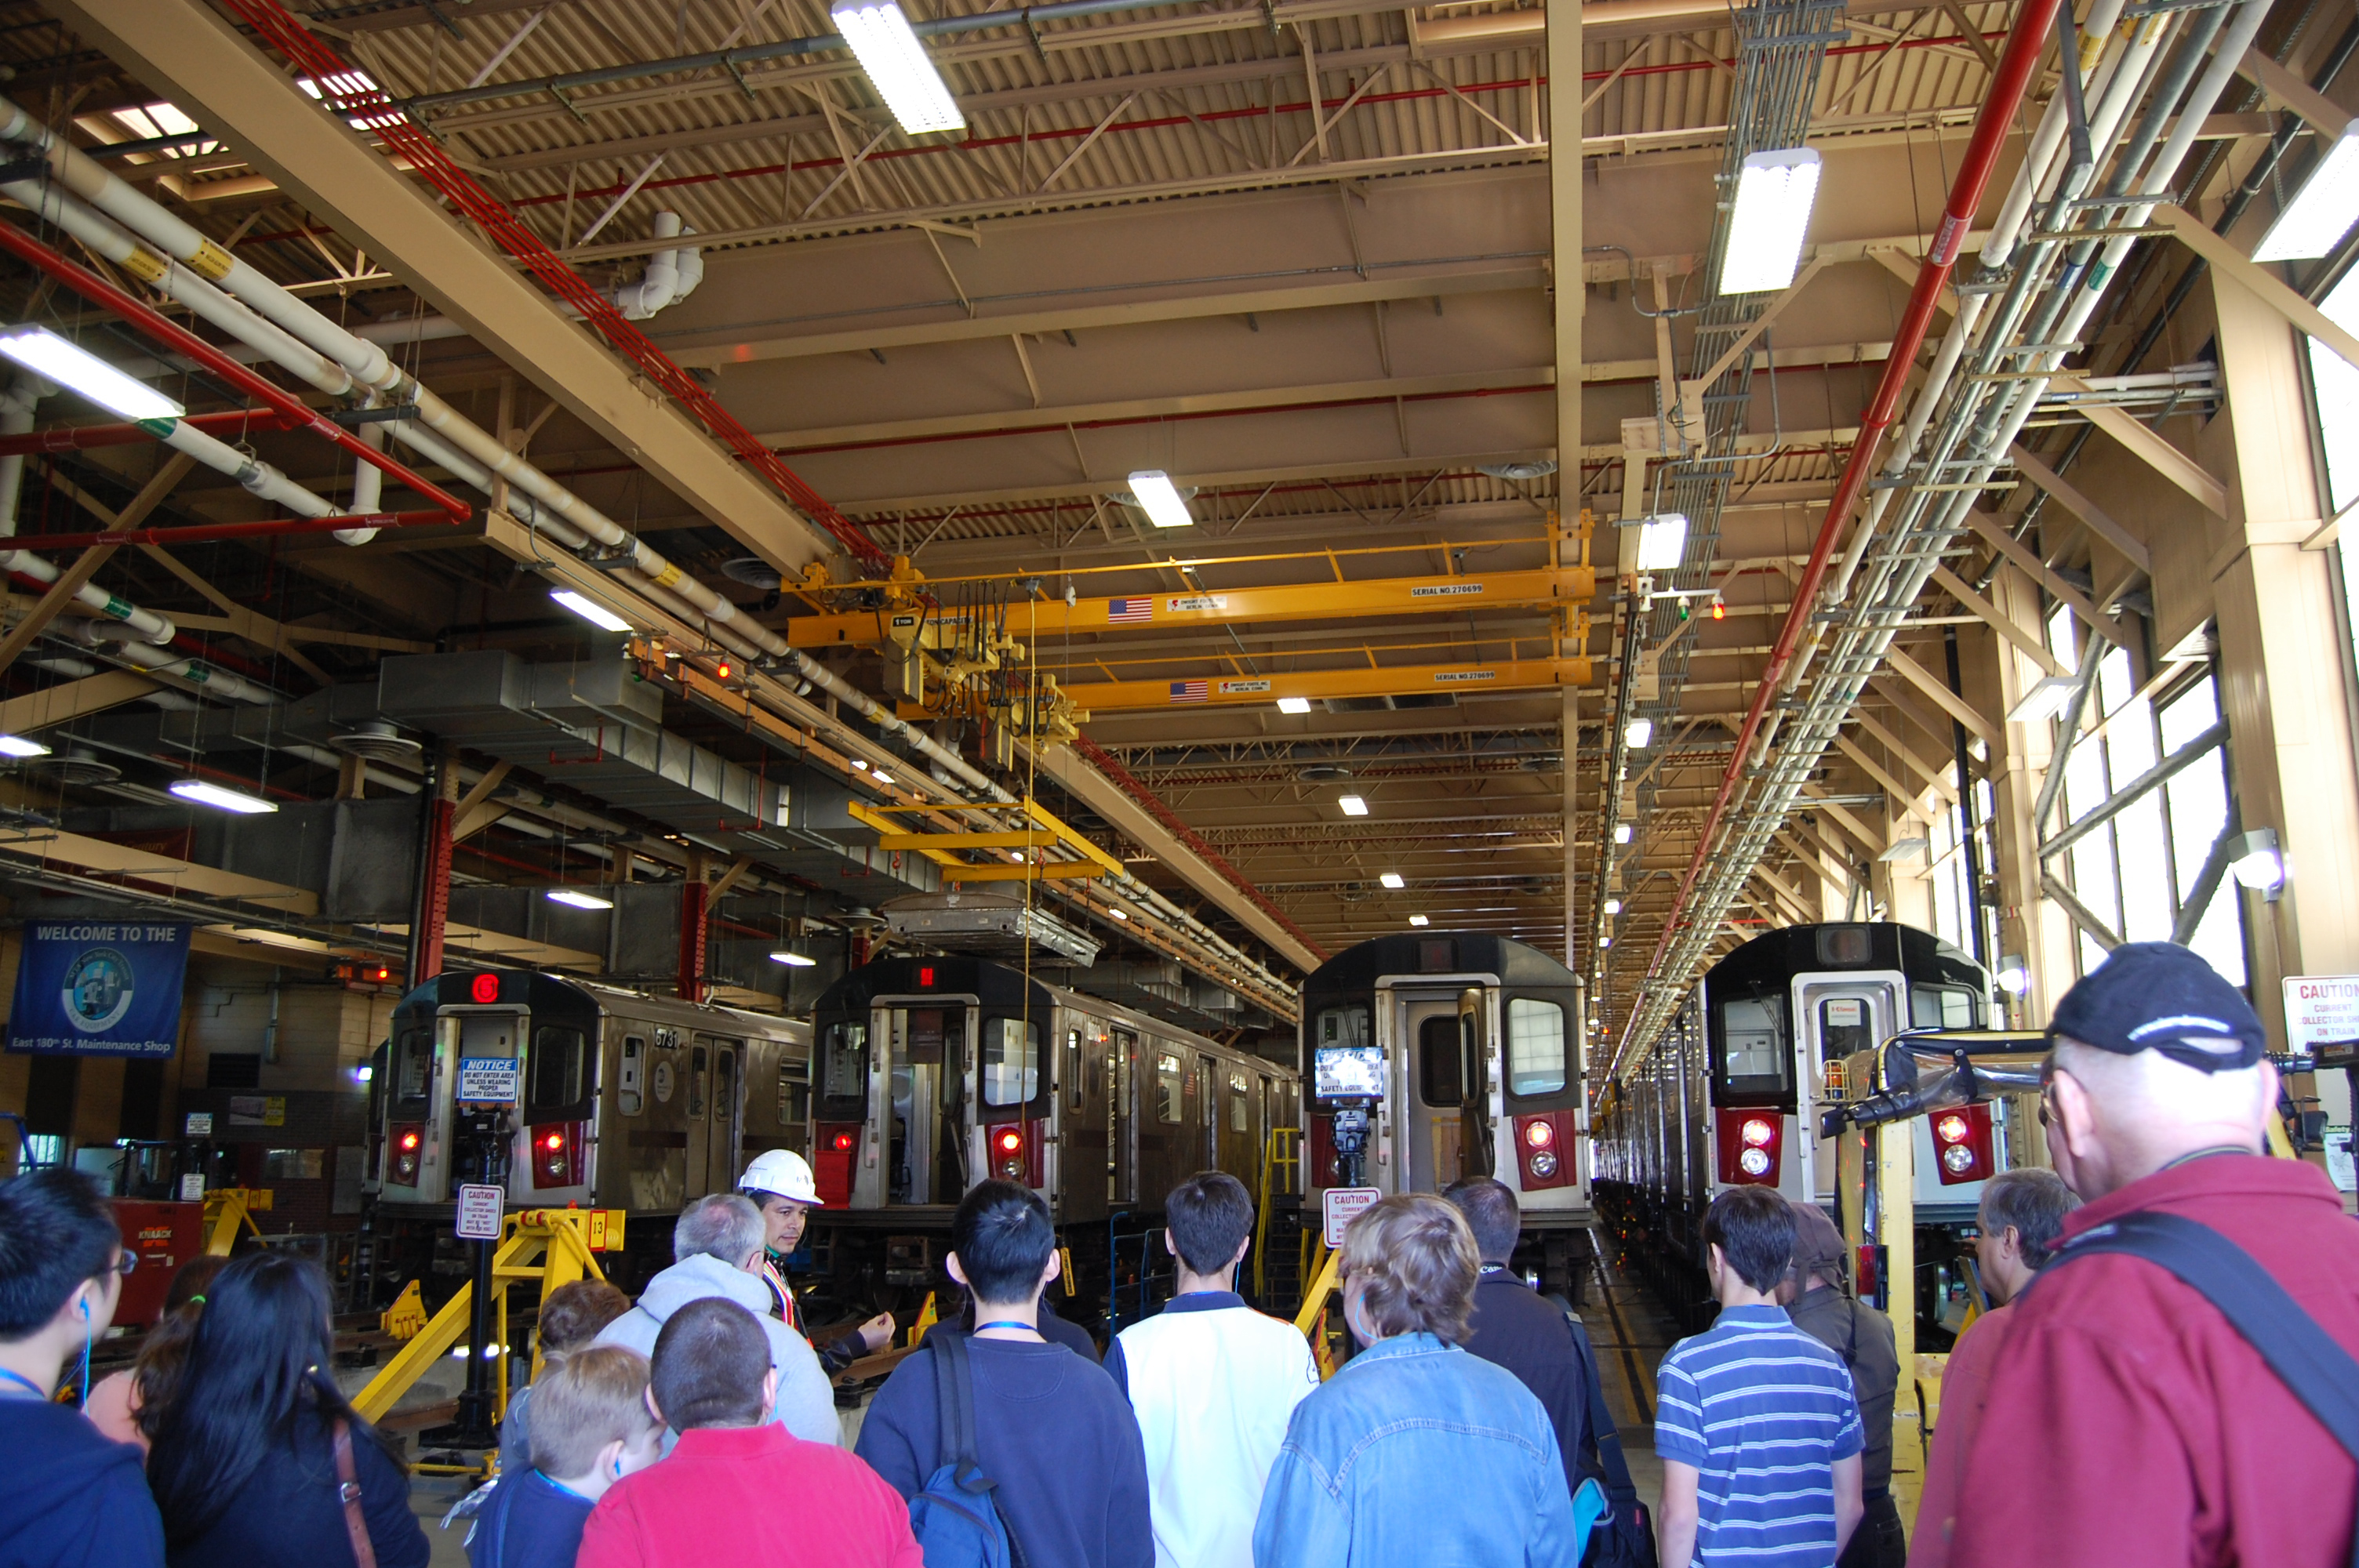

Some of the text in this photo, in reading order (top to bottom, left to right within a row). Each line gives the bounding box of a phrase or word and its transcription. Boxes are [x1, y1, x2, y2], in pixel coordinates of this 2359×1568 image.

[1412, 587, 1438, 596] SERIAL
[38, 926, 176, 942] WELCOME TO THE
[2314, 1004, 2352, 1013] CURRENT
[656, 1029, 678, 1047] 6731
[13, 1037, 34, 1047] East
[62, 1039, 74, 1048] St.
[77, 1039, 142, 1051] Maintenance
[144, 1040, 171, 1054] Shop
[467, 1061, 513, 1070] NOTICE
[468, 1191, 496, 1200] CAUTION
[1334, 1195, 1370, 1204] CAUTION
[594, 1221, 603, 1235] 13
[138, 1229, 173, 1240] KNAACK
